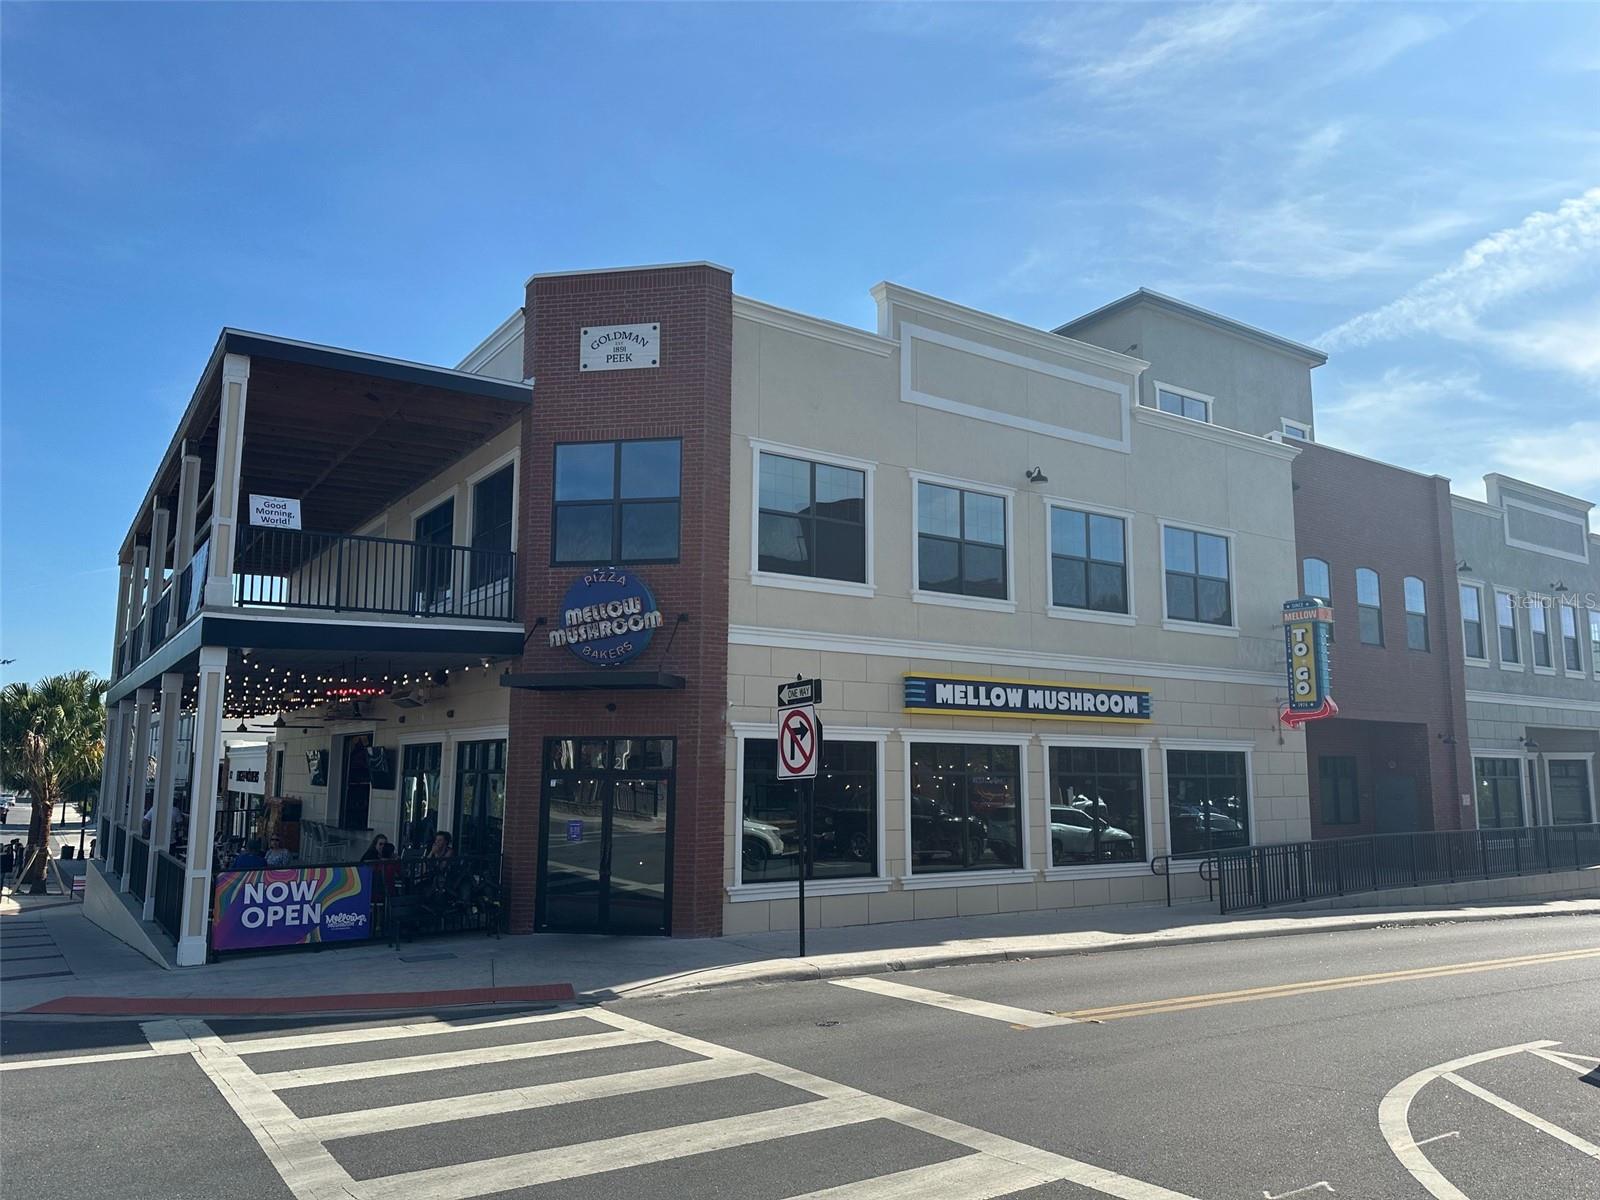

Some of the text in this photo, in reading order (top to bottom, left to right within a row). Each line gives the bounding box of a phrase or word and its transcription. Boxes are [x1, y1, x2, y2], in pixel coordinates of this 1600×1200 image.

[590, 331, 649, 350] GOLDMAN
[606, 353, 633, 363] PEEK
[255, 507, 295, 519] Morning,
[263, 501, 287, 510] Good
[260, 515, 291, 525] World!
[584, 571, 627, 586] PIZZA
[565, 596, 641, 626] MELLOW
[1284, 609, 1317, 622] MELLOW
[549, 610, 664, 648] MUSHROOM
[582, 641, 633, 660] BAKERS
[787, 686, 810, 699] ONE WAY
[935, 683, 1139, 714] MELLOW MUSHROOM
[243, 879, 318, 905] NOW
[241, 903, 321, 929] OPEN
